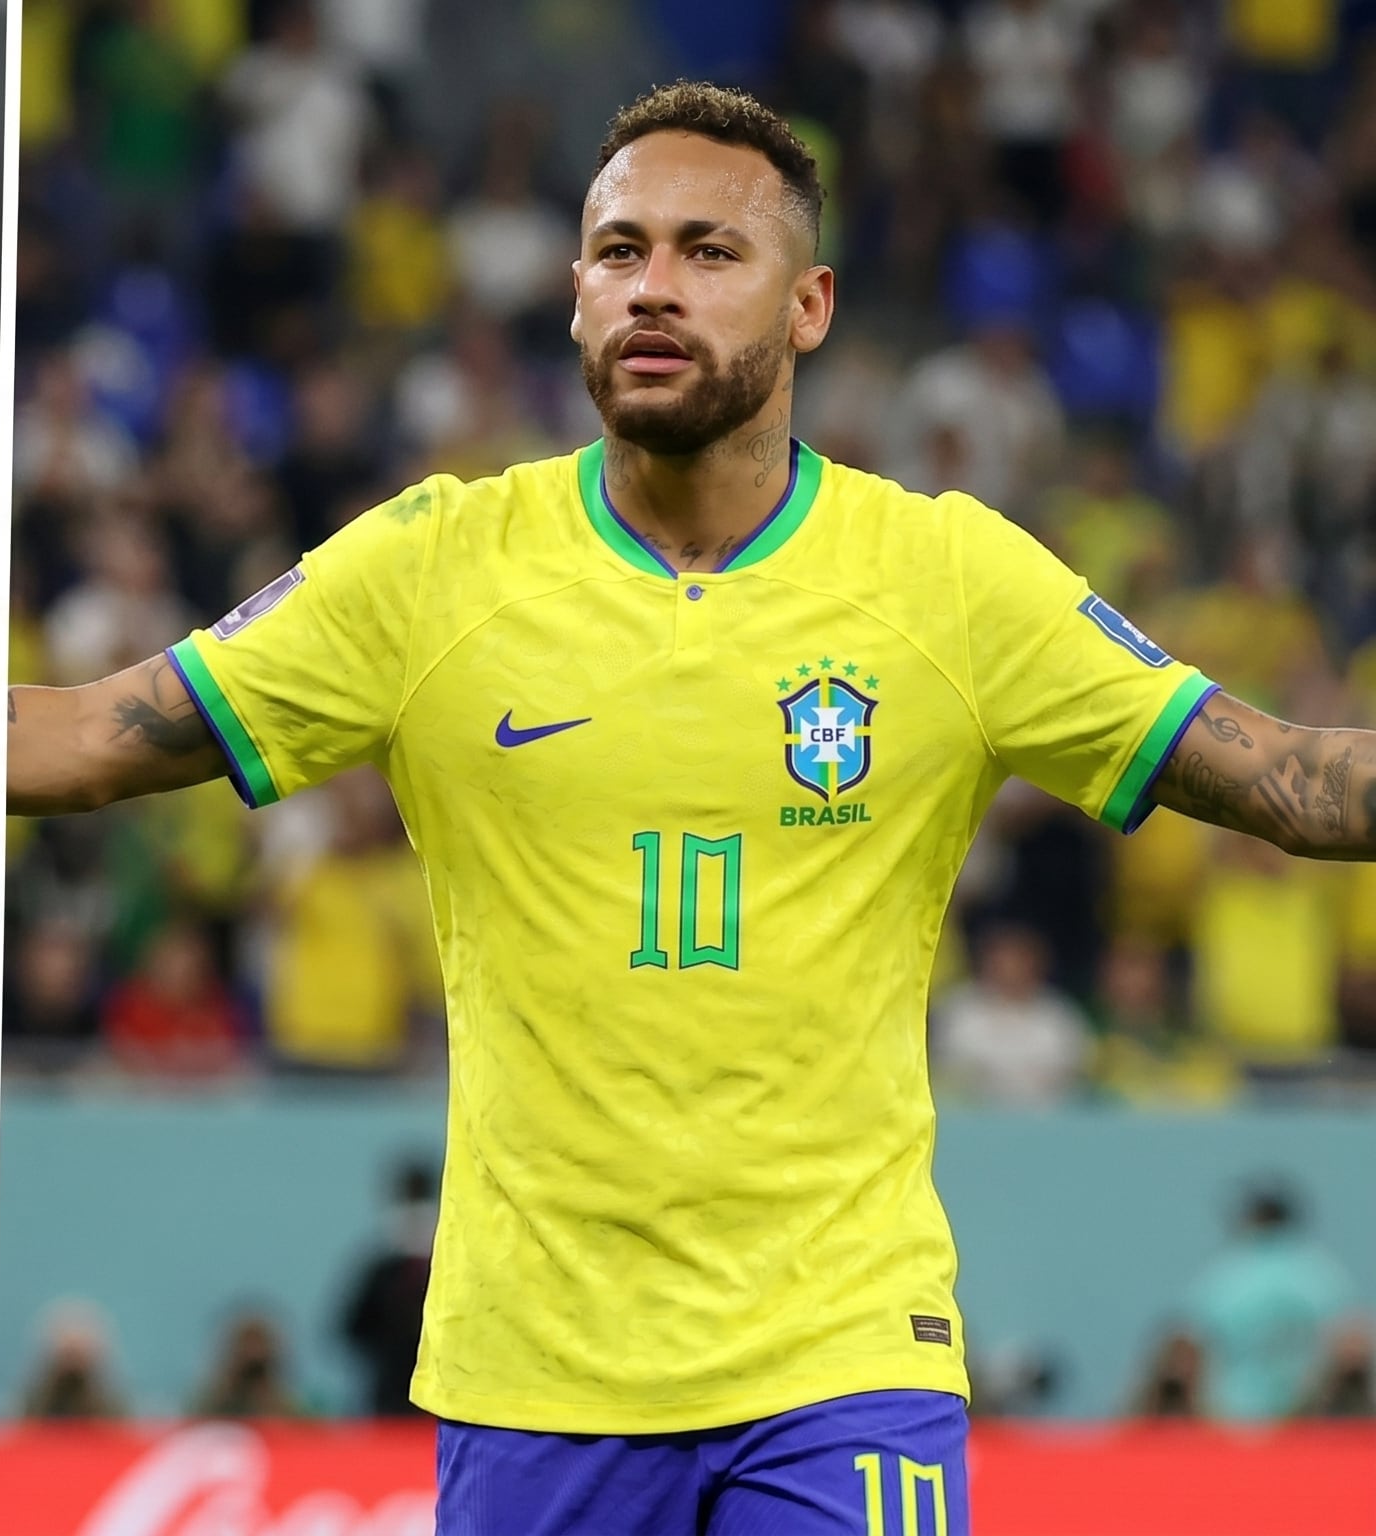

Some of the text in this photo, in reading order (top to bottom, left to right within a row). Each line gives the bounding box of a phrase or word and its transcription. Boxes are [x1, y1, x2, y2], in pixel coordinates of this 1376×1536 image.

[809, 727, 847, 743] CBF
[779, 802, 873, 827] BRASIL
[629, 831, 743, 972] 10
[853, 1452, 949, 1536] 10
